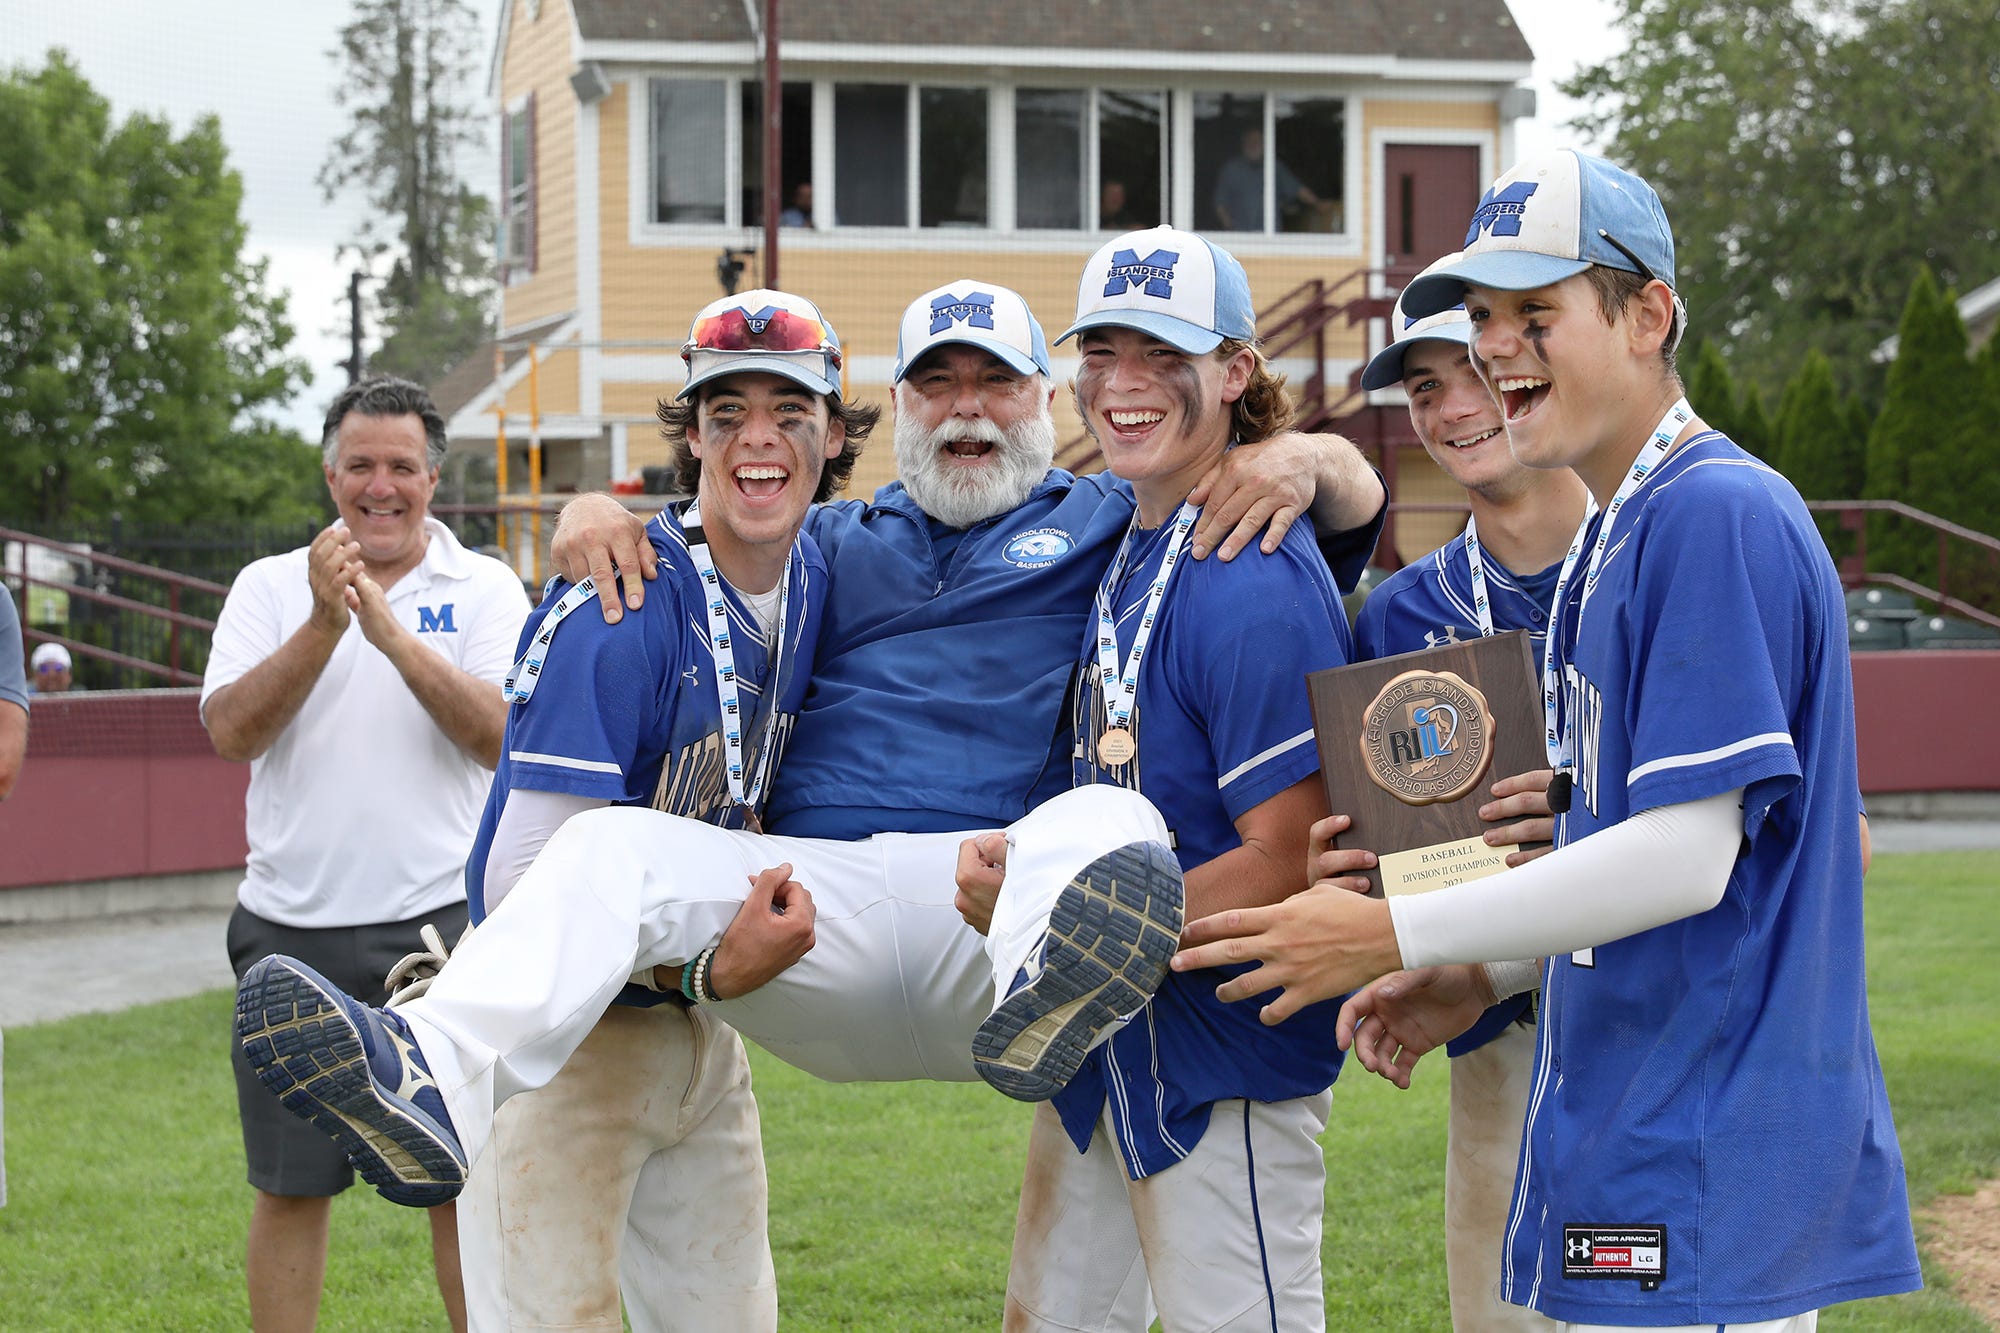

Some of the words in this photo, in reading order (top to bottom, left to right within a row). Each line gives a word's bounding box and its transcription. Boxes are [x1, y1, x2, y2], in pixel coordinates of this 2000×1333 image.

[1103, 248, 1180, 300] M
[1107, 266, 1175, 280] ISLANDERS
[930, 303, 993, 320] ISLANDERS
[930, 291, 994, 336] M
[1011, 527, 1070, 541] MIDDLETOWN
[1016, 559, 1056, 569] BASEBALL
[417, 603, 458, 632] M
[1371, 682, 1415, 726] RHODE
[1419, 680, 1470, 713] ISLAND
[1369, 742, 1463, 794] INTERSCHOLASTIC
[1460, 722, 1481, 772] LEAGUE
[1421, 845, 1476, 863] BASEBALL
[1402, 868, 1441, 883] DIVISION
[1441, 866, 1449, 876] II
[1449, 855, 1501, 874] CHAMPIONS
[1442, 877, 1463, 889] 2021
[1594, 1252, 1629, 1262] AUTHENTIC
